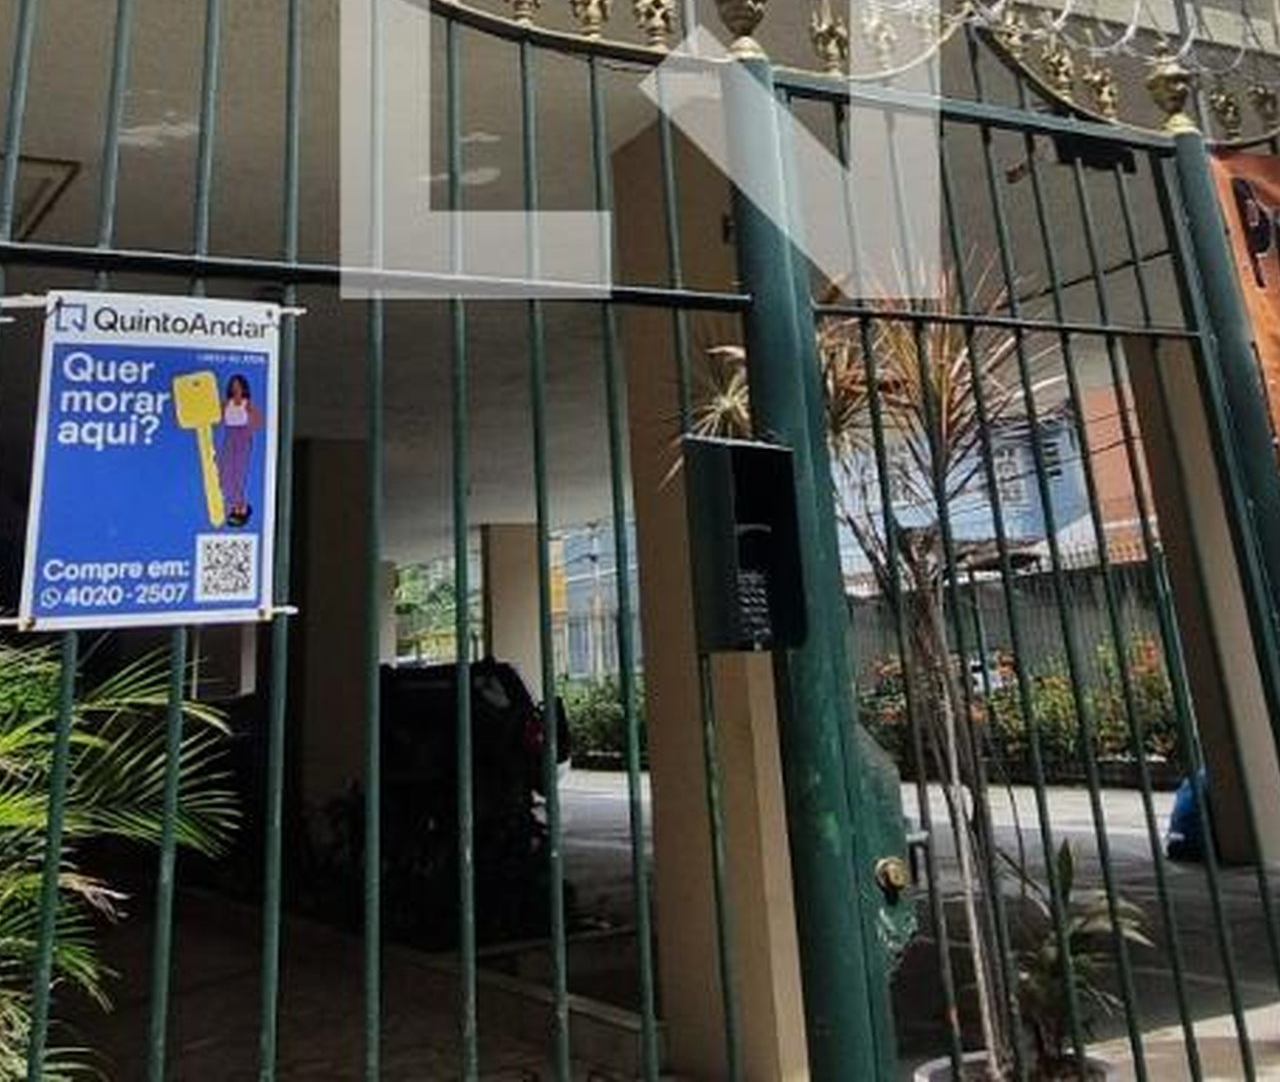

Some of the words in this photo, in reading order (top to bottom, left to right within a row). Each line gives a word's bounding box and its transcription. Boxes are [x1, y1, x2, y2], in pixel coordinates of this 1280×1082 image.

[94, 307, 269, 339] QuintoAndar
[63, 352, 154, 384] Quer
[60, 390, 170, 414] morar
[58, 416, 160, 449] aqui?
[43, 560, 142, 585] Compre
[147, 560, 190, 578] em:
